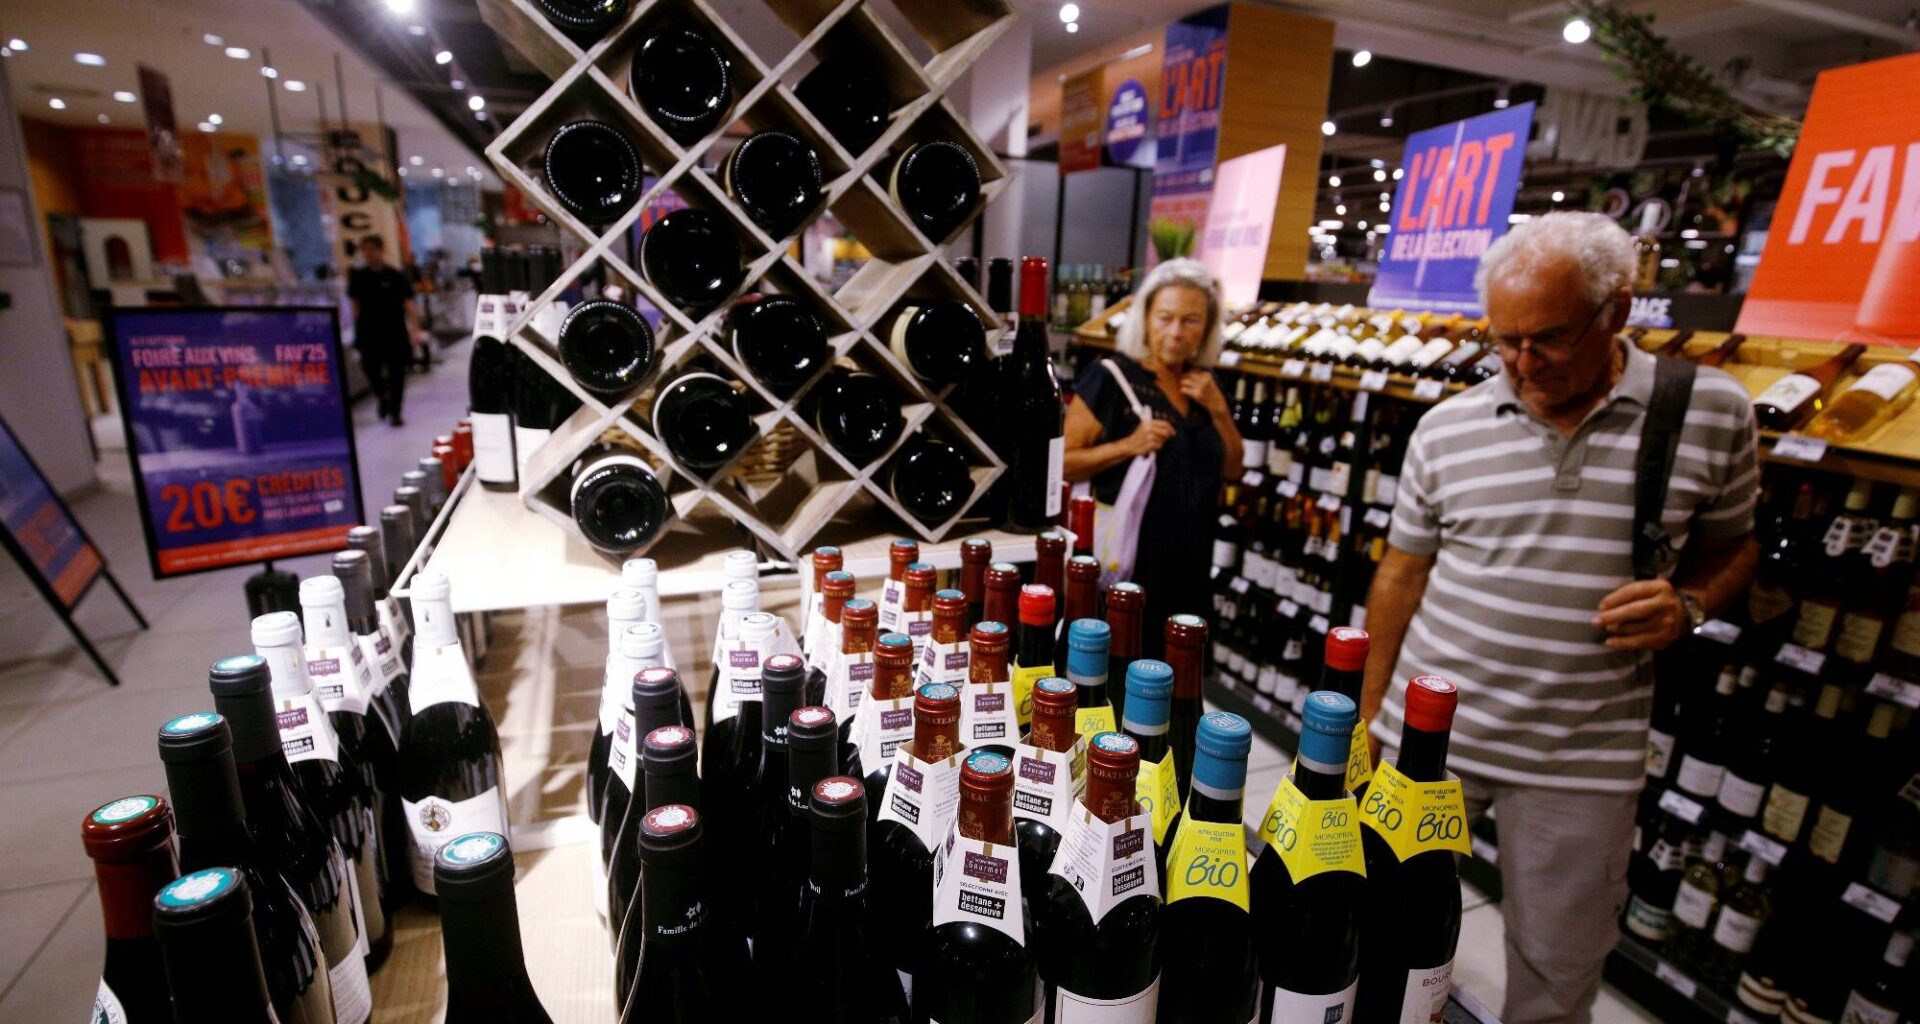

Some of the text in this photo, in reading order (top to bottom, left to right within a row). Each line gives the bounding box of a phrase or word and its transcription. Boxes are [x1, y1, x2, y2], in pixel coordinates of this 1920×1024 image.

[1398, 132, 1515, 231] L'ART
[131, 342, 329, 367] FOIRE AUX VINS FAV'25
[257, 467, 345, 493] CRÉDITÉS
[161, 478, 256, 533] 20€
[883, 715, 910, 725] Gourmet
[1022, 766, 1052, 778] Gourmet
[1016, 791, 1041, 806] bettane
[1015, 801, 1049, 815] desseauve
[968, 860, 1003, 875] Gourmet
[961, 892, 1002, 909] bettane +
[960, 900, 1001, 918] desseauve
[657, 924, 688, 935] Famille
